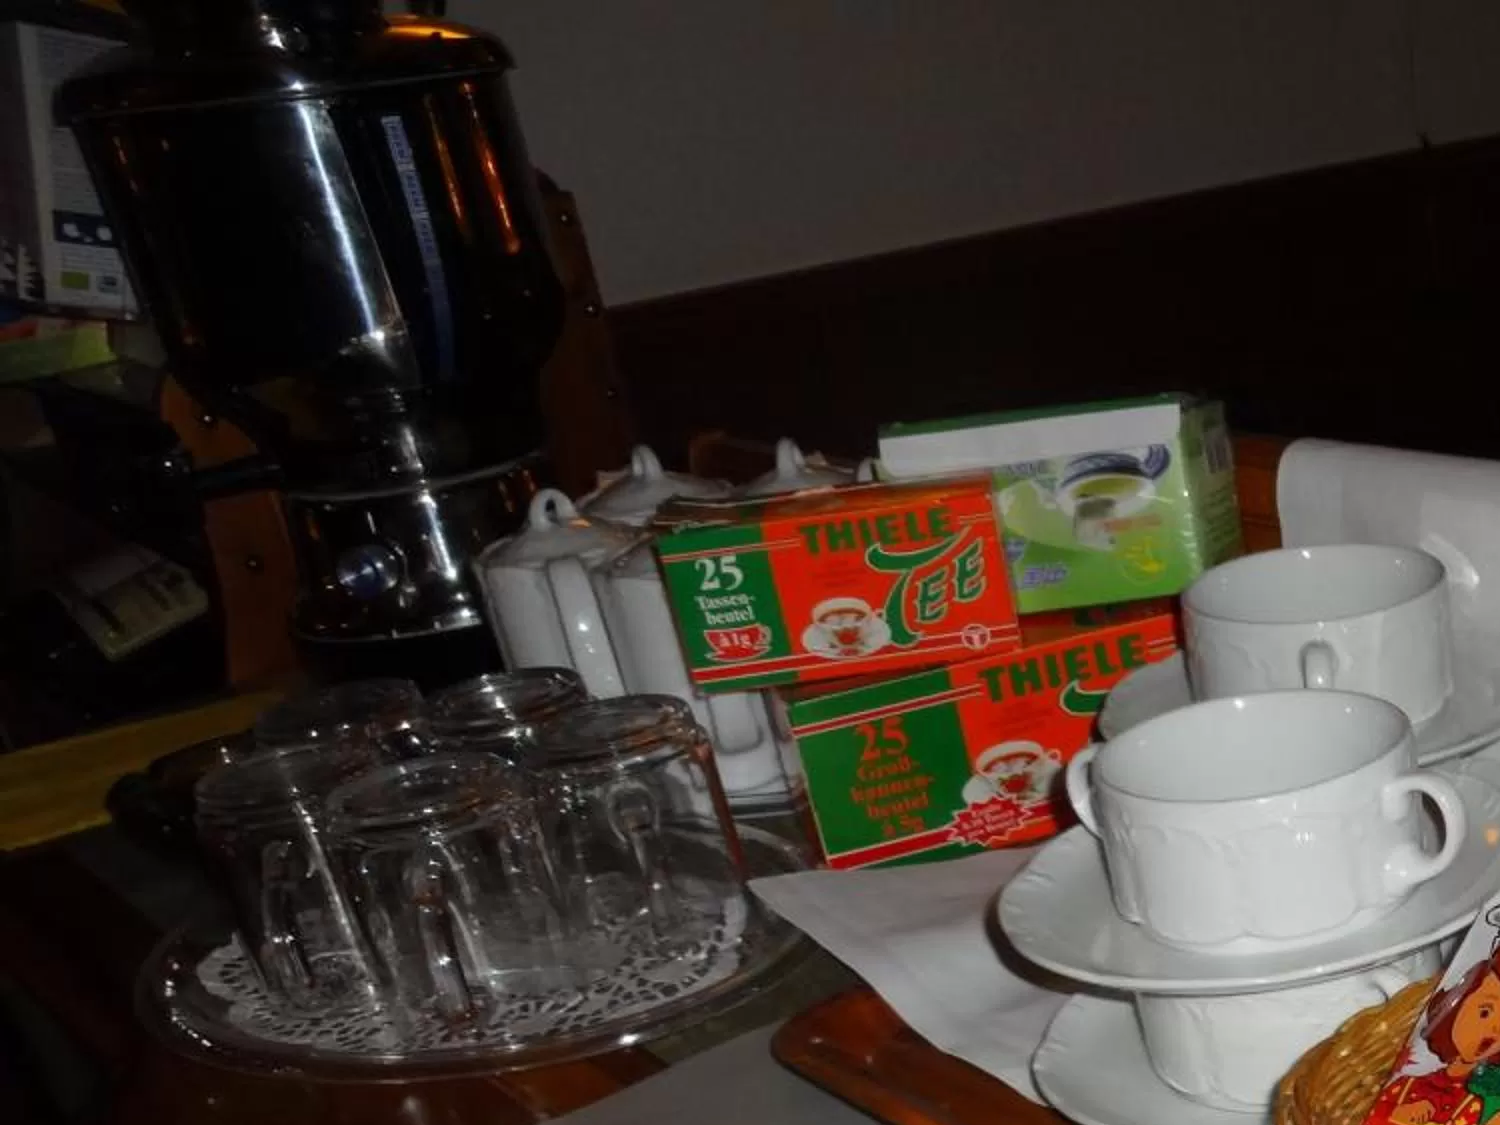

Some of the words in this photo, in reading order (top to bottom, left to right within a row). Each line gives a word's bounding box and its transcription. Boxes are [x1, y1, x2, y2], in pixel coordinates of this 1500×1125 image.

[801, 507, 952, 554] THIELE
[694, 554, 744, 591] 25
[864, 525, 986, 647] TEE
[705, 606, 755, 625] beutel
[977, 634, 1147, 703] THIELE
[855, 716, 910, 760] 25
